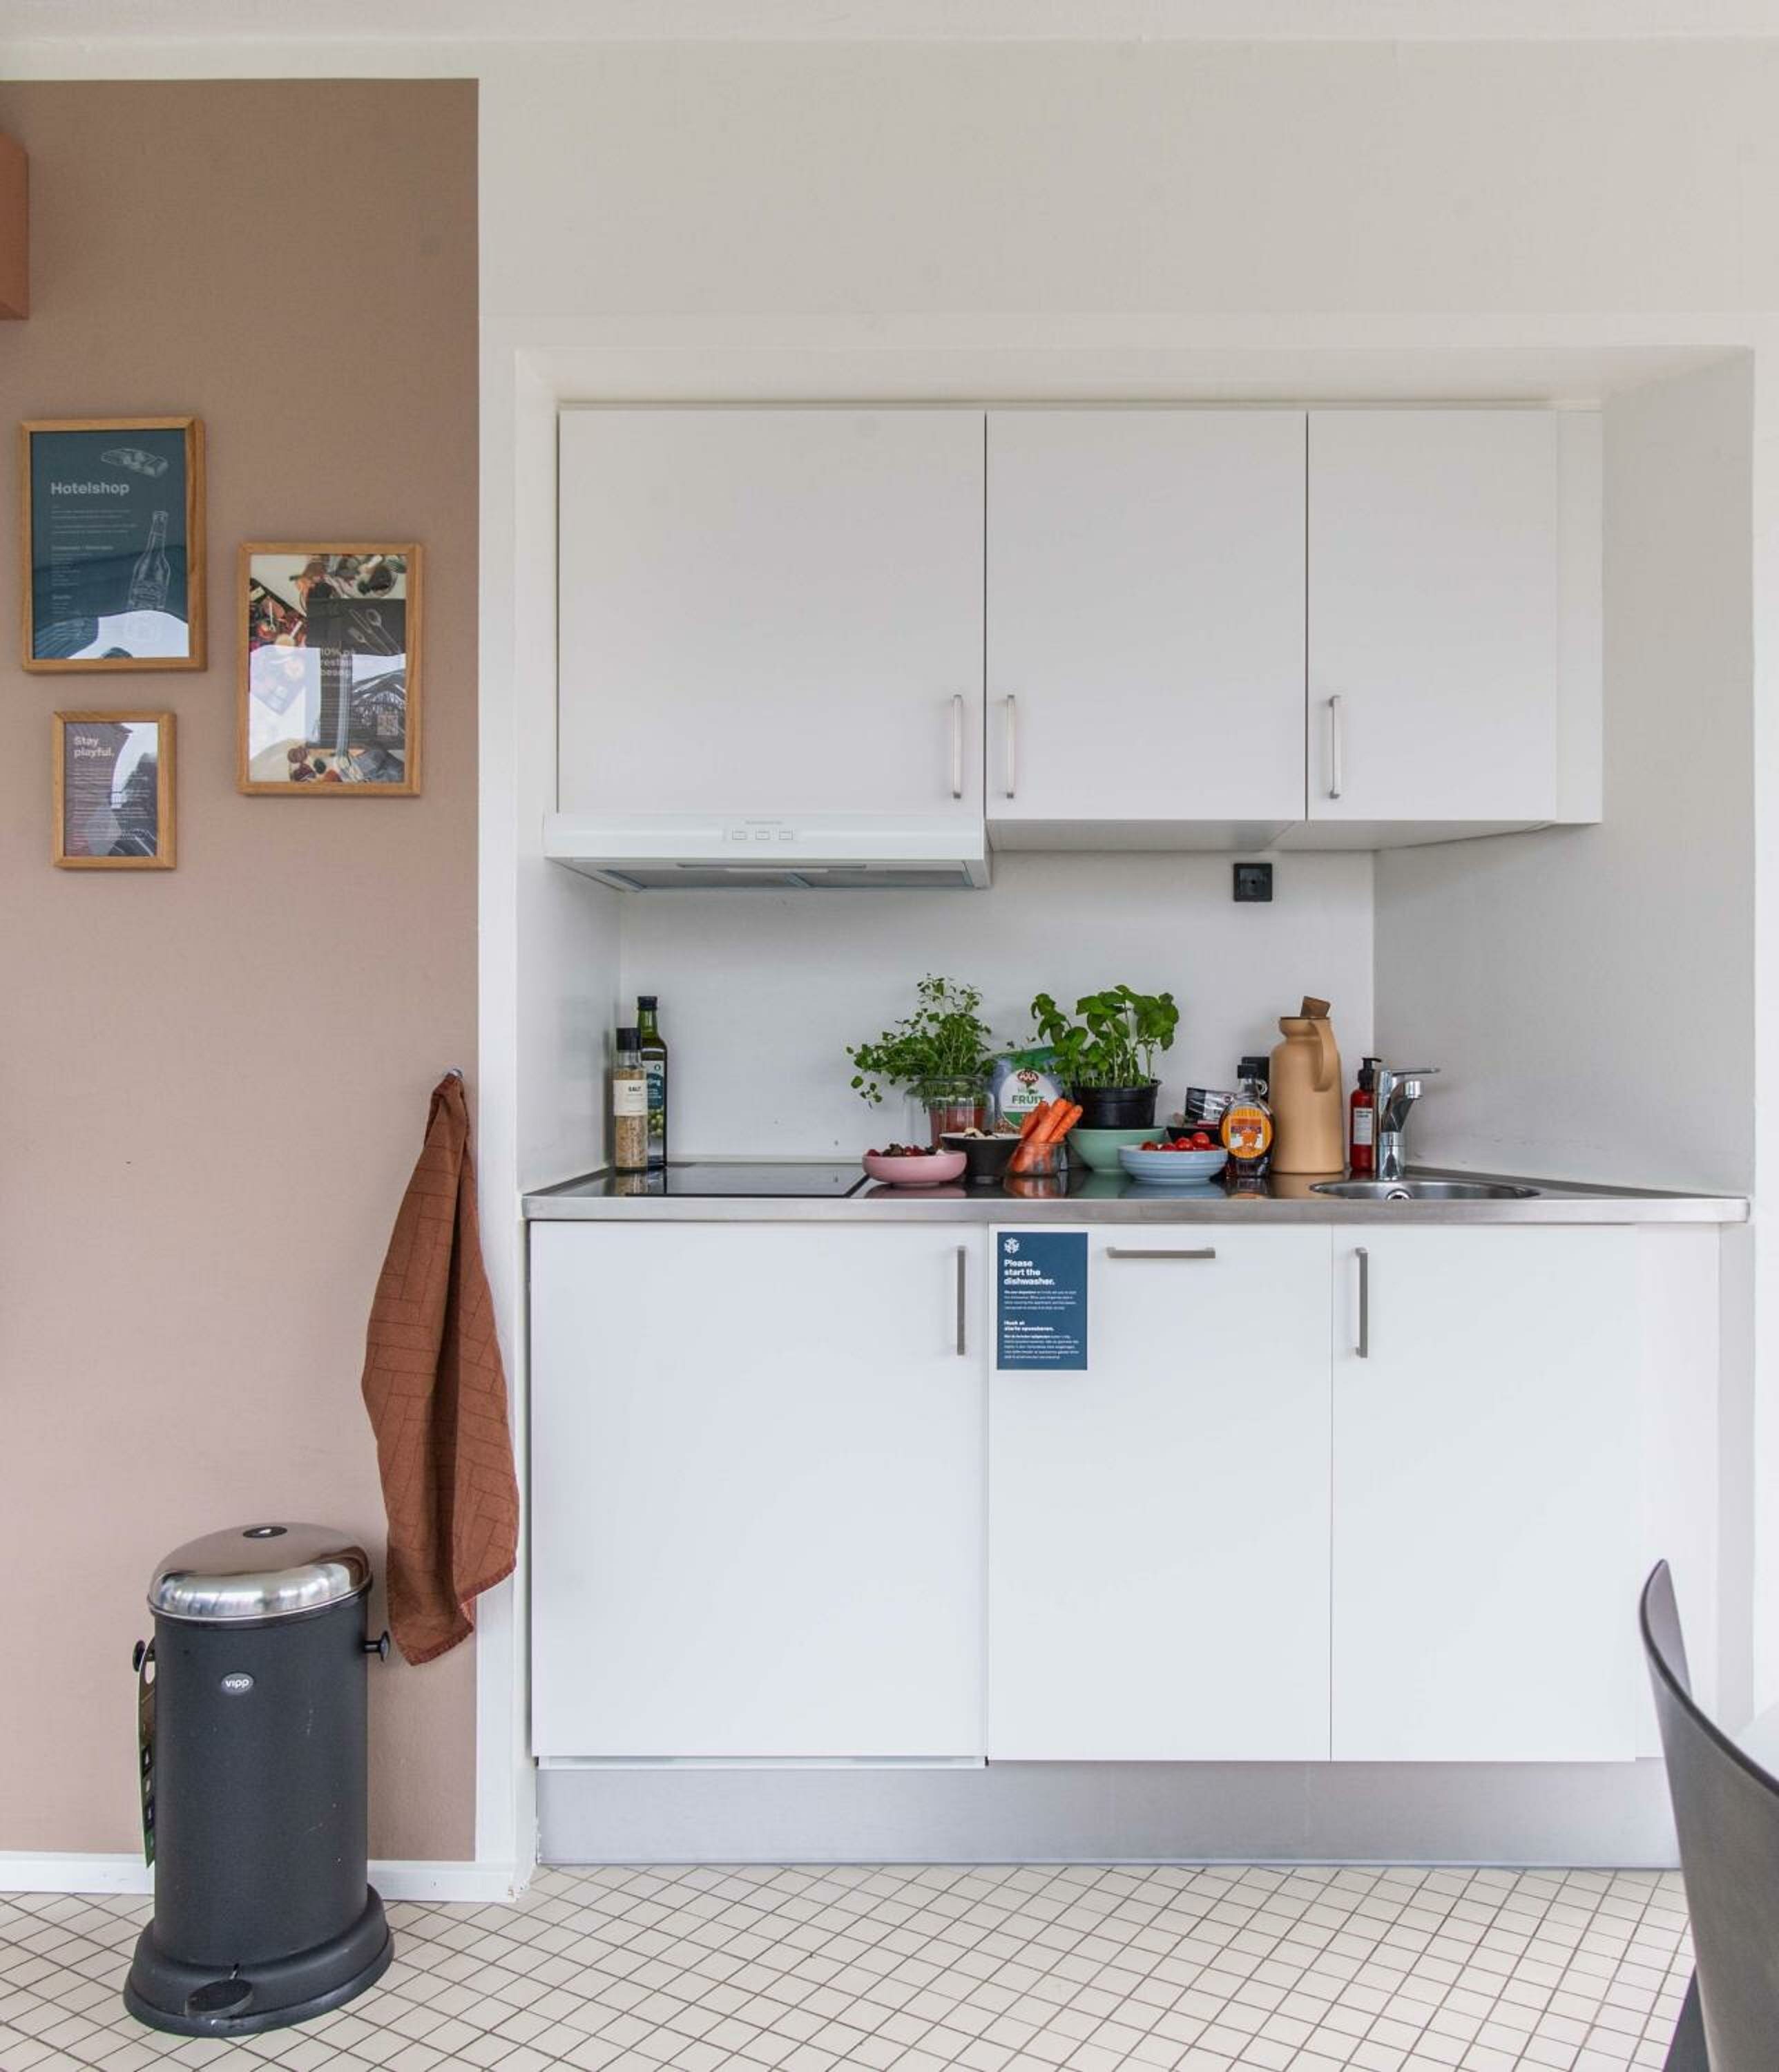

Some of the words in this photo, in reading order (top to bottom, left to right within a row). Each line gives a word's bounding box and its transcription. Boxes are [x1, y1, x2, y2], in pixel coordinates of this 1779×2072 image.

[51, 481, 130, 497] Hotelshop
[74, 736, 99, 747] Stay
[74, 746, 115, 759] playful.
[1003, 1259, 1033, 1267] Please
[1003, 1268, 1025, 1276] start
[1026, 1268, 1041, 1276] the
[1003, 1277, 1055, 1285] dishwasher.
[225, 1679, 249, 1689] vipp
